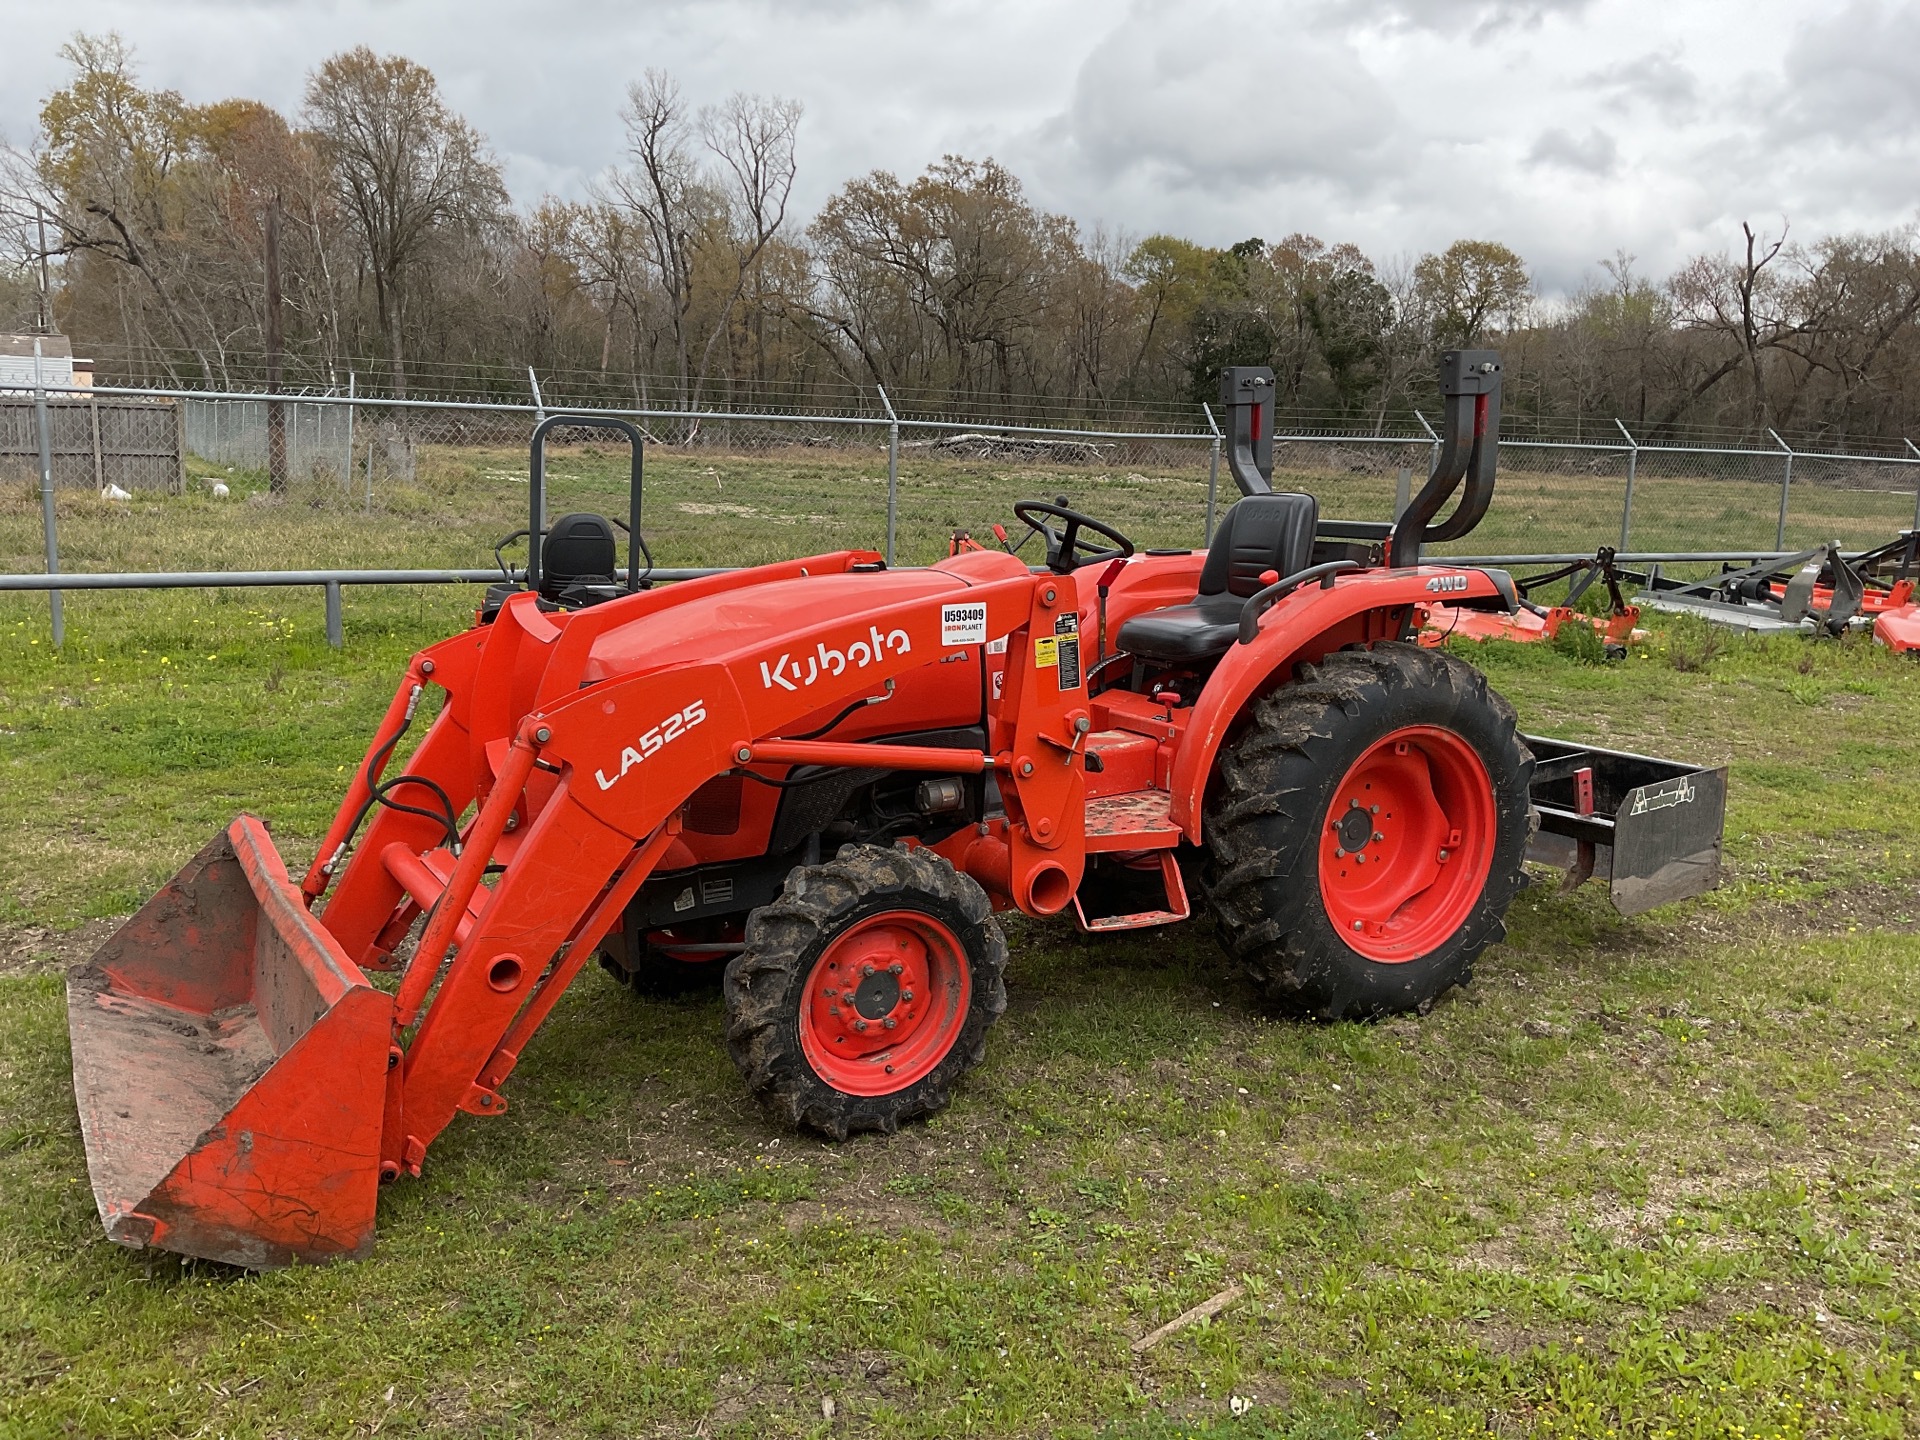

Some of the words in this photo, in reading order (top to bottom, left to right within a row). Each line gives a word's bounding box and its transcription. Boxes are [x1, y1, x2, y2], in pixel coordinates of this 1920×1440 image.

[1425, 575, 1468, 593] 4WD
[944, 608, 984, 622] U593409
[759, 625, 911, 691] Kubota
[594, 698, 707, 791] LA525
